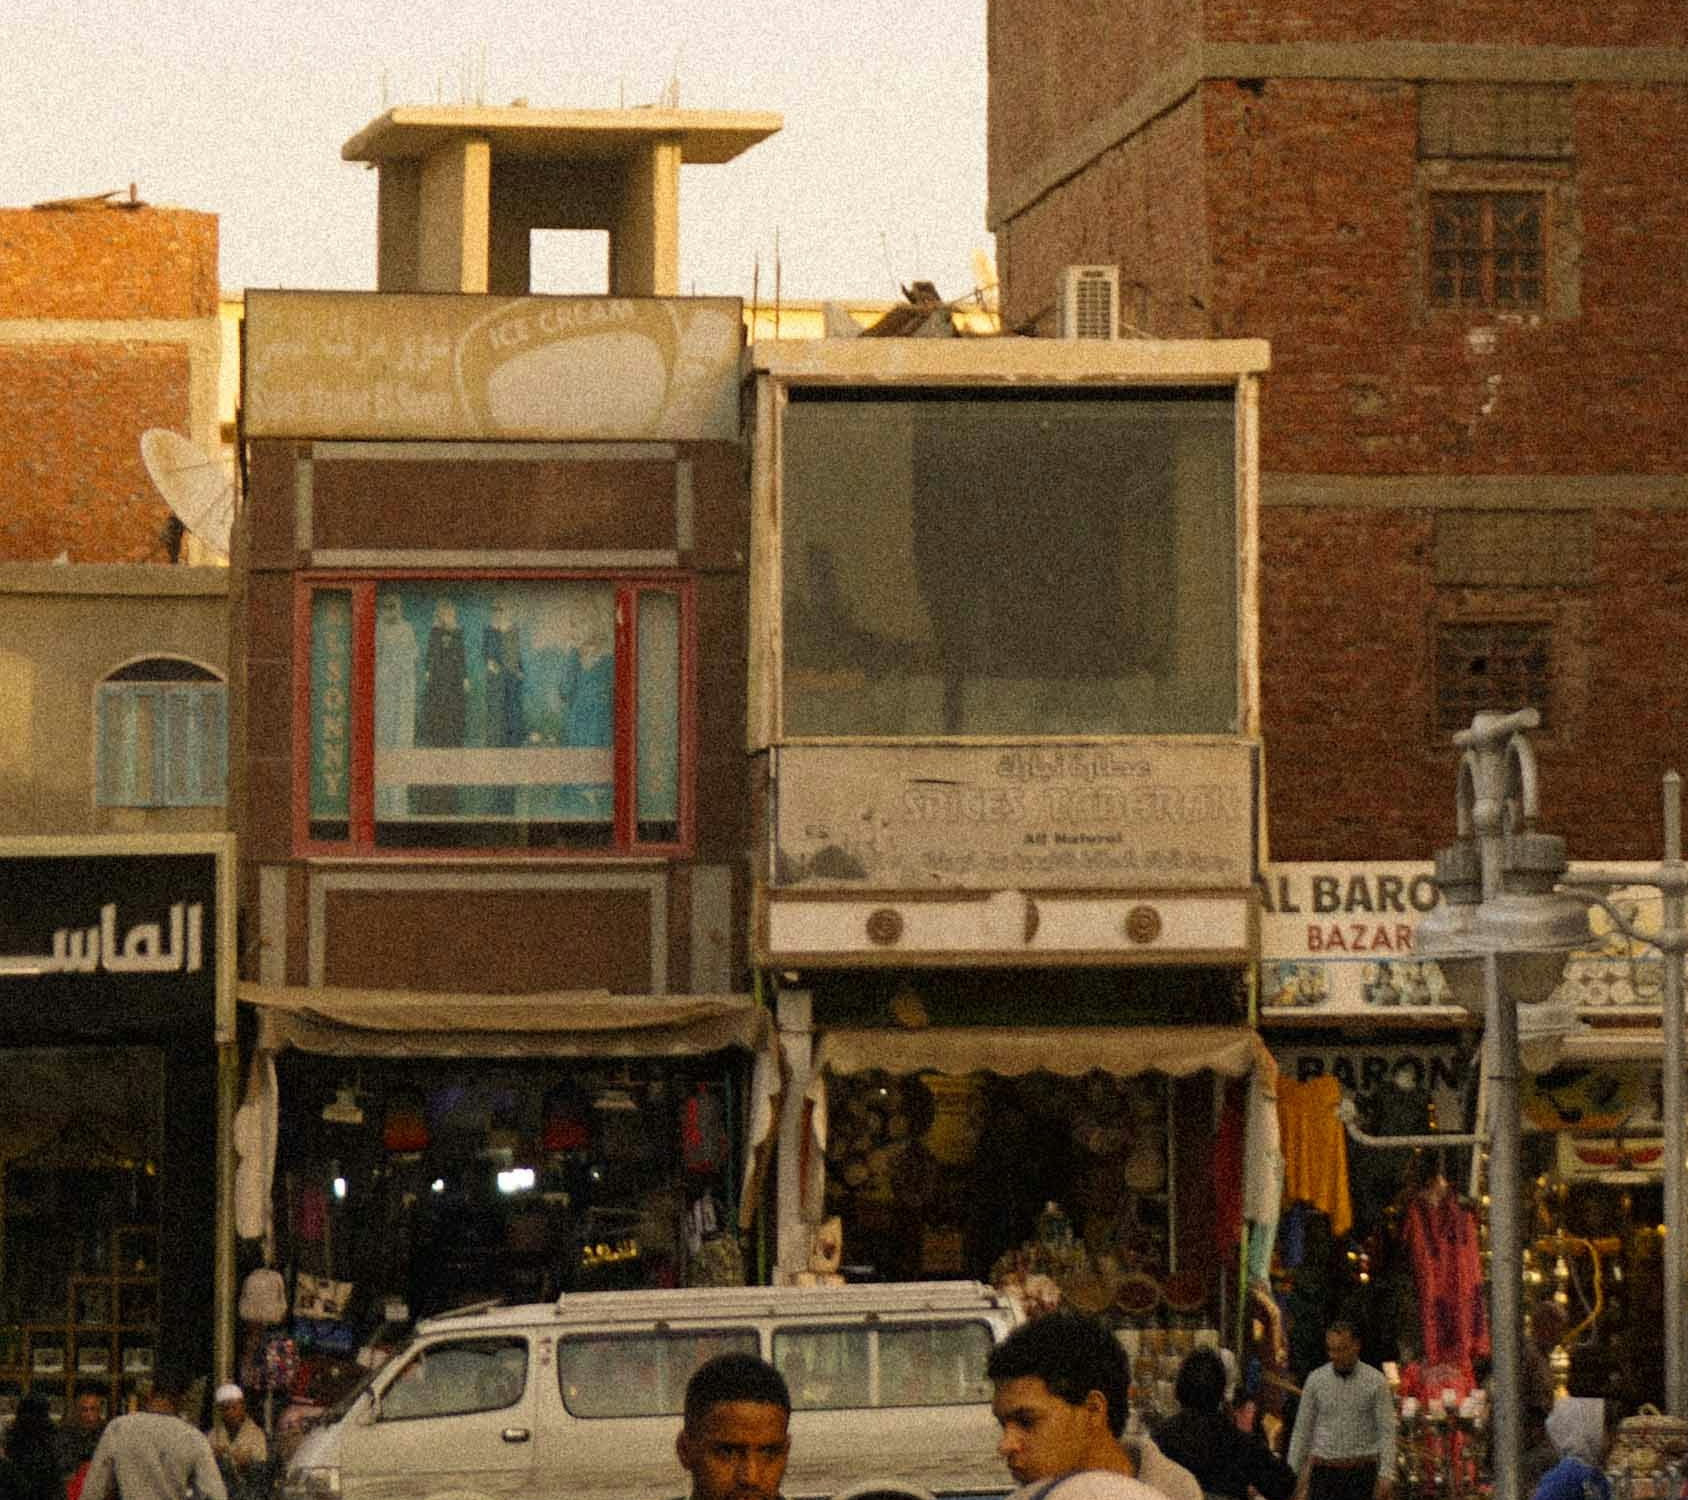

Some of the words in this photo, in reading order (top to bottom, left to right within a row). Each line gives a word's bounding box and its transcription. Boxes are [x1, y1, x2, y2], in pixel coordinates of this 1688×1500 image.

[488, 317, 530, 350] ICE
[538, 299, 637, 334] CREAM
[1311, 873, 1441, 914] BARO
[0, 901, 203, 975] الماس
[1306, 924, 1413, 952] BAZAR
